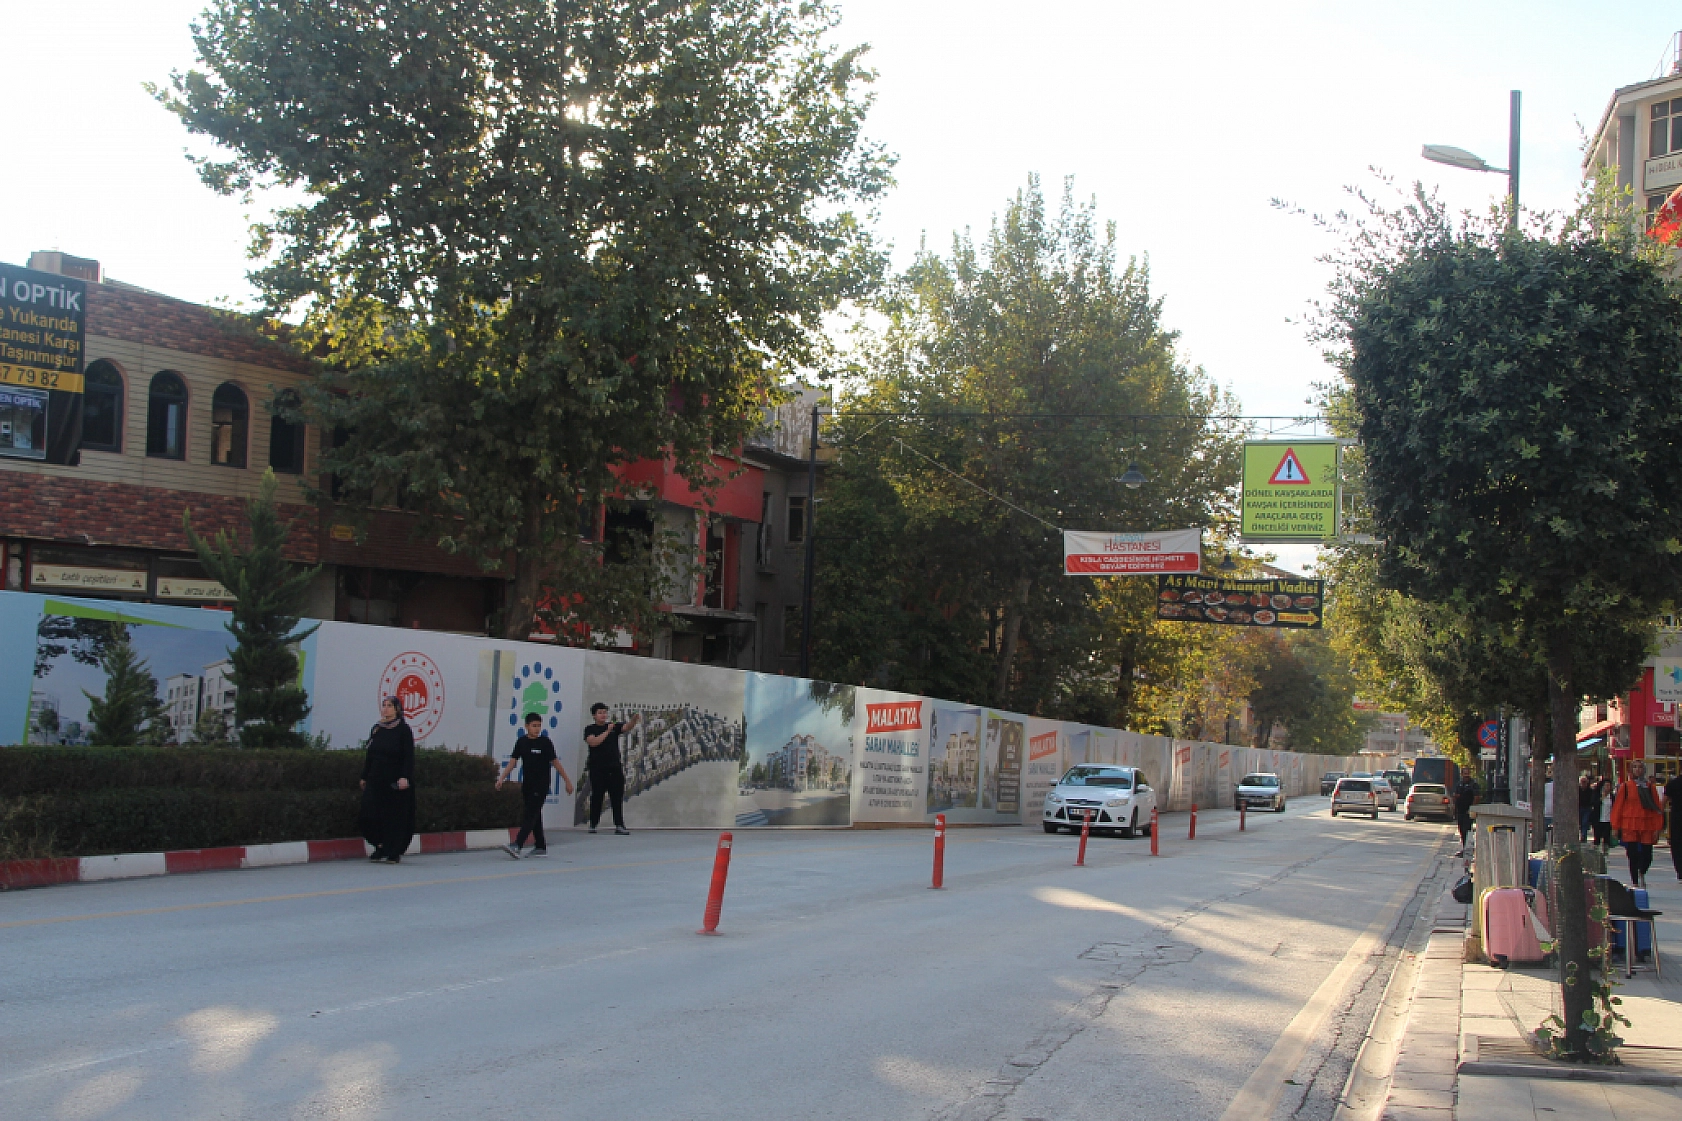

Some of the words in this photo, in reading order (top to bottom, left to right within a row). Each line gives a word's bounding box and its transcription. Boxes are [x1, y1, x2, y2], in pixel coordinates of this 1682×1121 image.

[13, 280, 82, 312] OPTİK
[8, 305, 78, 333] Yukarıda
[44, 331, 80, 354] Karşı
[16, 367, 36, 383] 79
[40, 371, 59, 387] 82
[1245, 488, 1273, 498] DÖNEL
[1274, 489, 1333, 499] KAVŞAKLARDA
[1246, 500, 1278, 510] KAVŞAK
[1255, 512, 1297, 521] ARAÇLARA
[1299, 511, 1324, 521] GEÇİŞ
[1251, 522, 1289, 532] ÖNCELİĞİ
[1278, 581, 1319, 594] Vadisi
[870, 707, 918, 728] MALATYA
